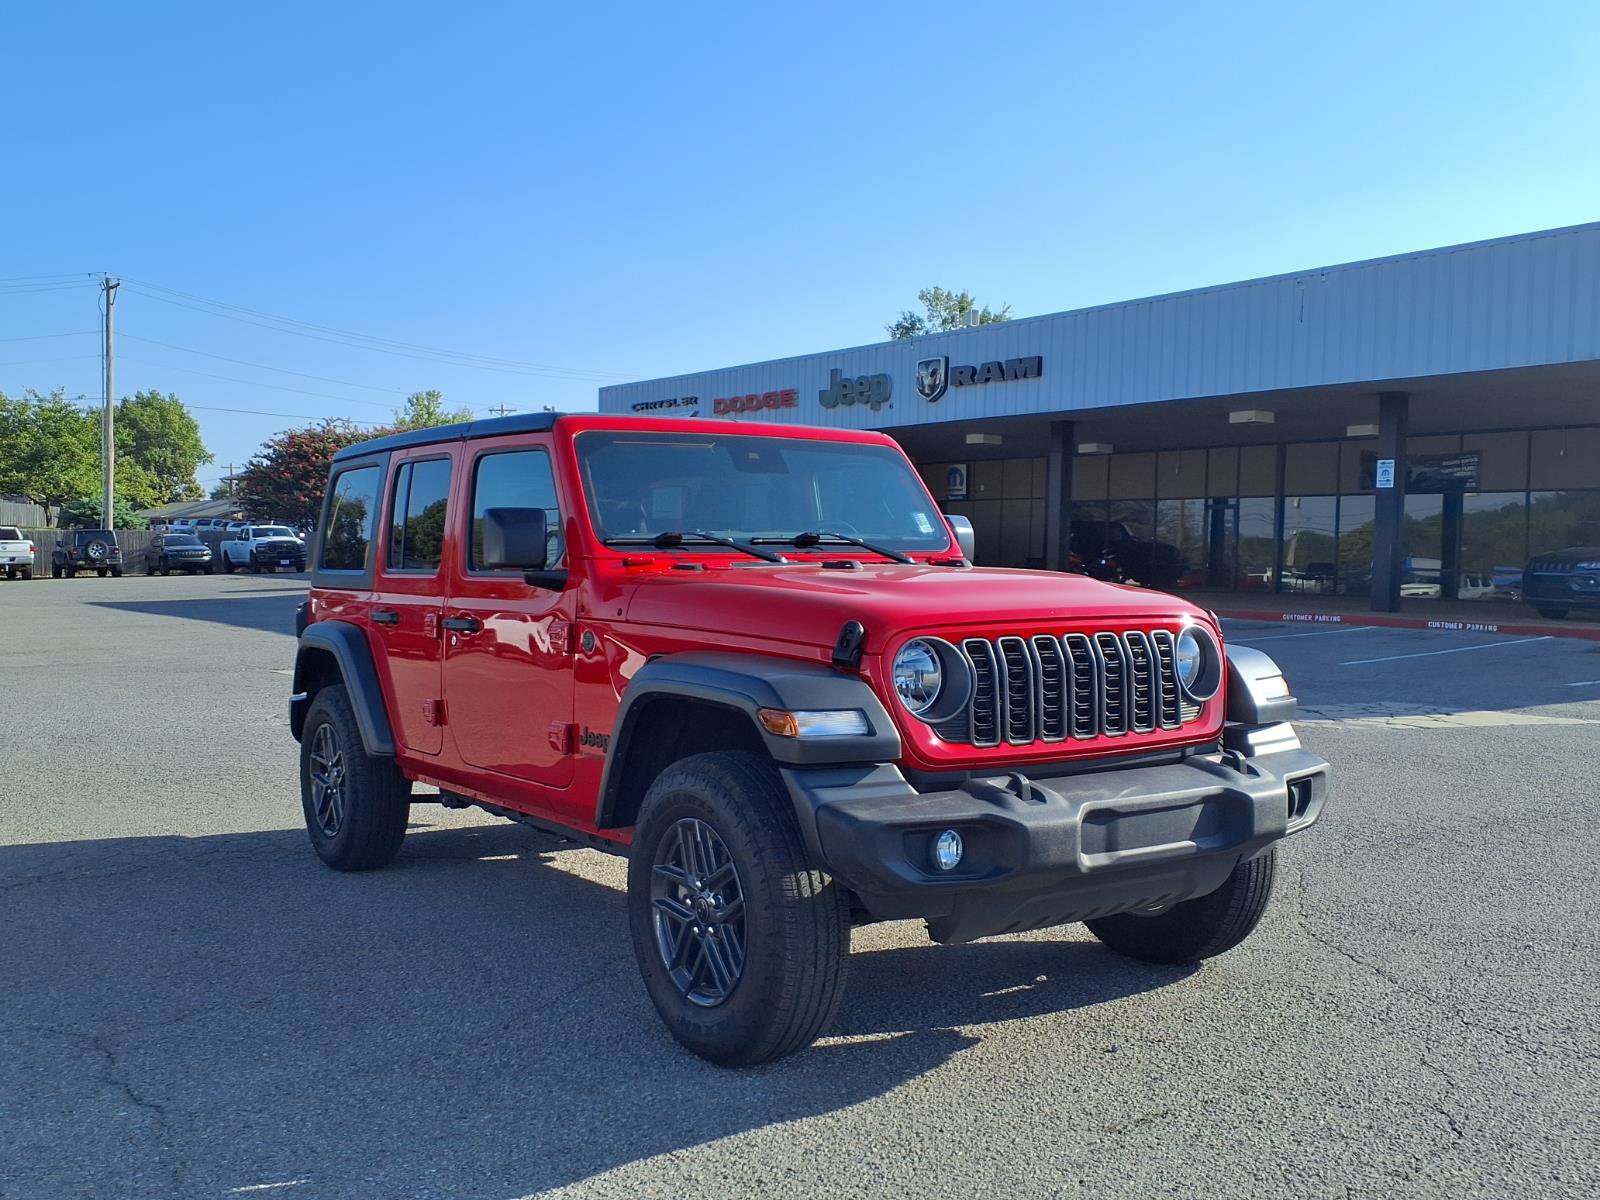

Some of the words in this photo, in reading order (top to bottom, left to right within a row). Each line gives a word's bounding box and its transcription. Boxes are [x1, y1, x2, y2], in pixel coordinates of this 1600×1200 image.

[950, 356, 1043, 387] RAM
[713, 389, 798, 415] DODGE
[819, 368, 892, 411] Jeep
[632, 396, 698, 412] CHRYSLER
[1427, 621, 1463, 629] CUSTOMER
[1466, 623, 1498, 631] PARKING
